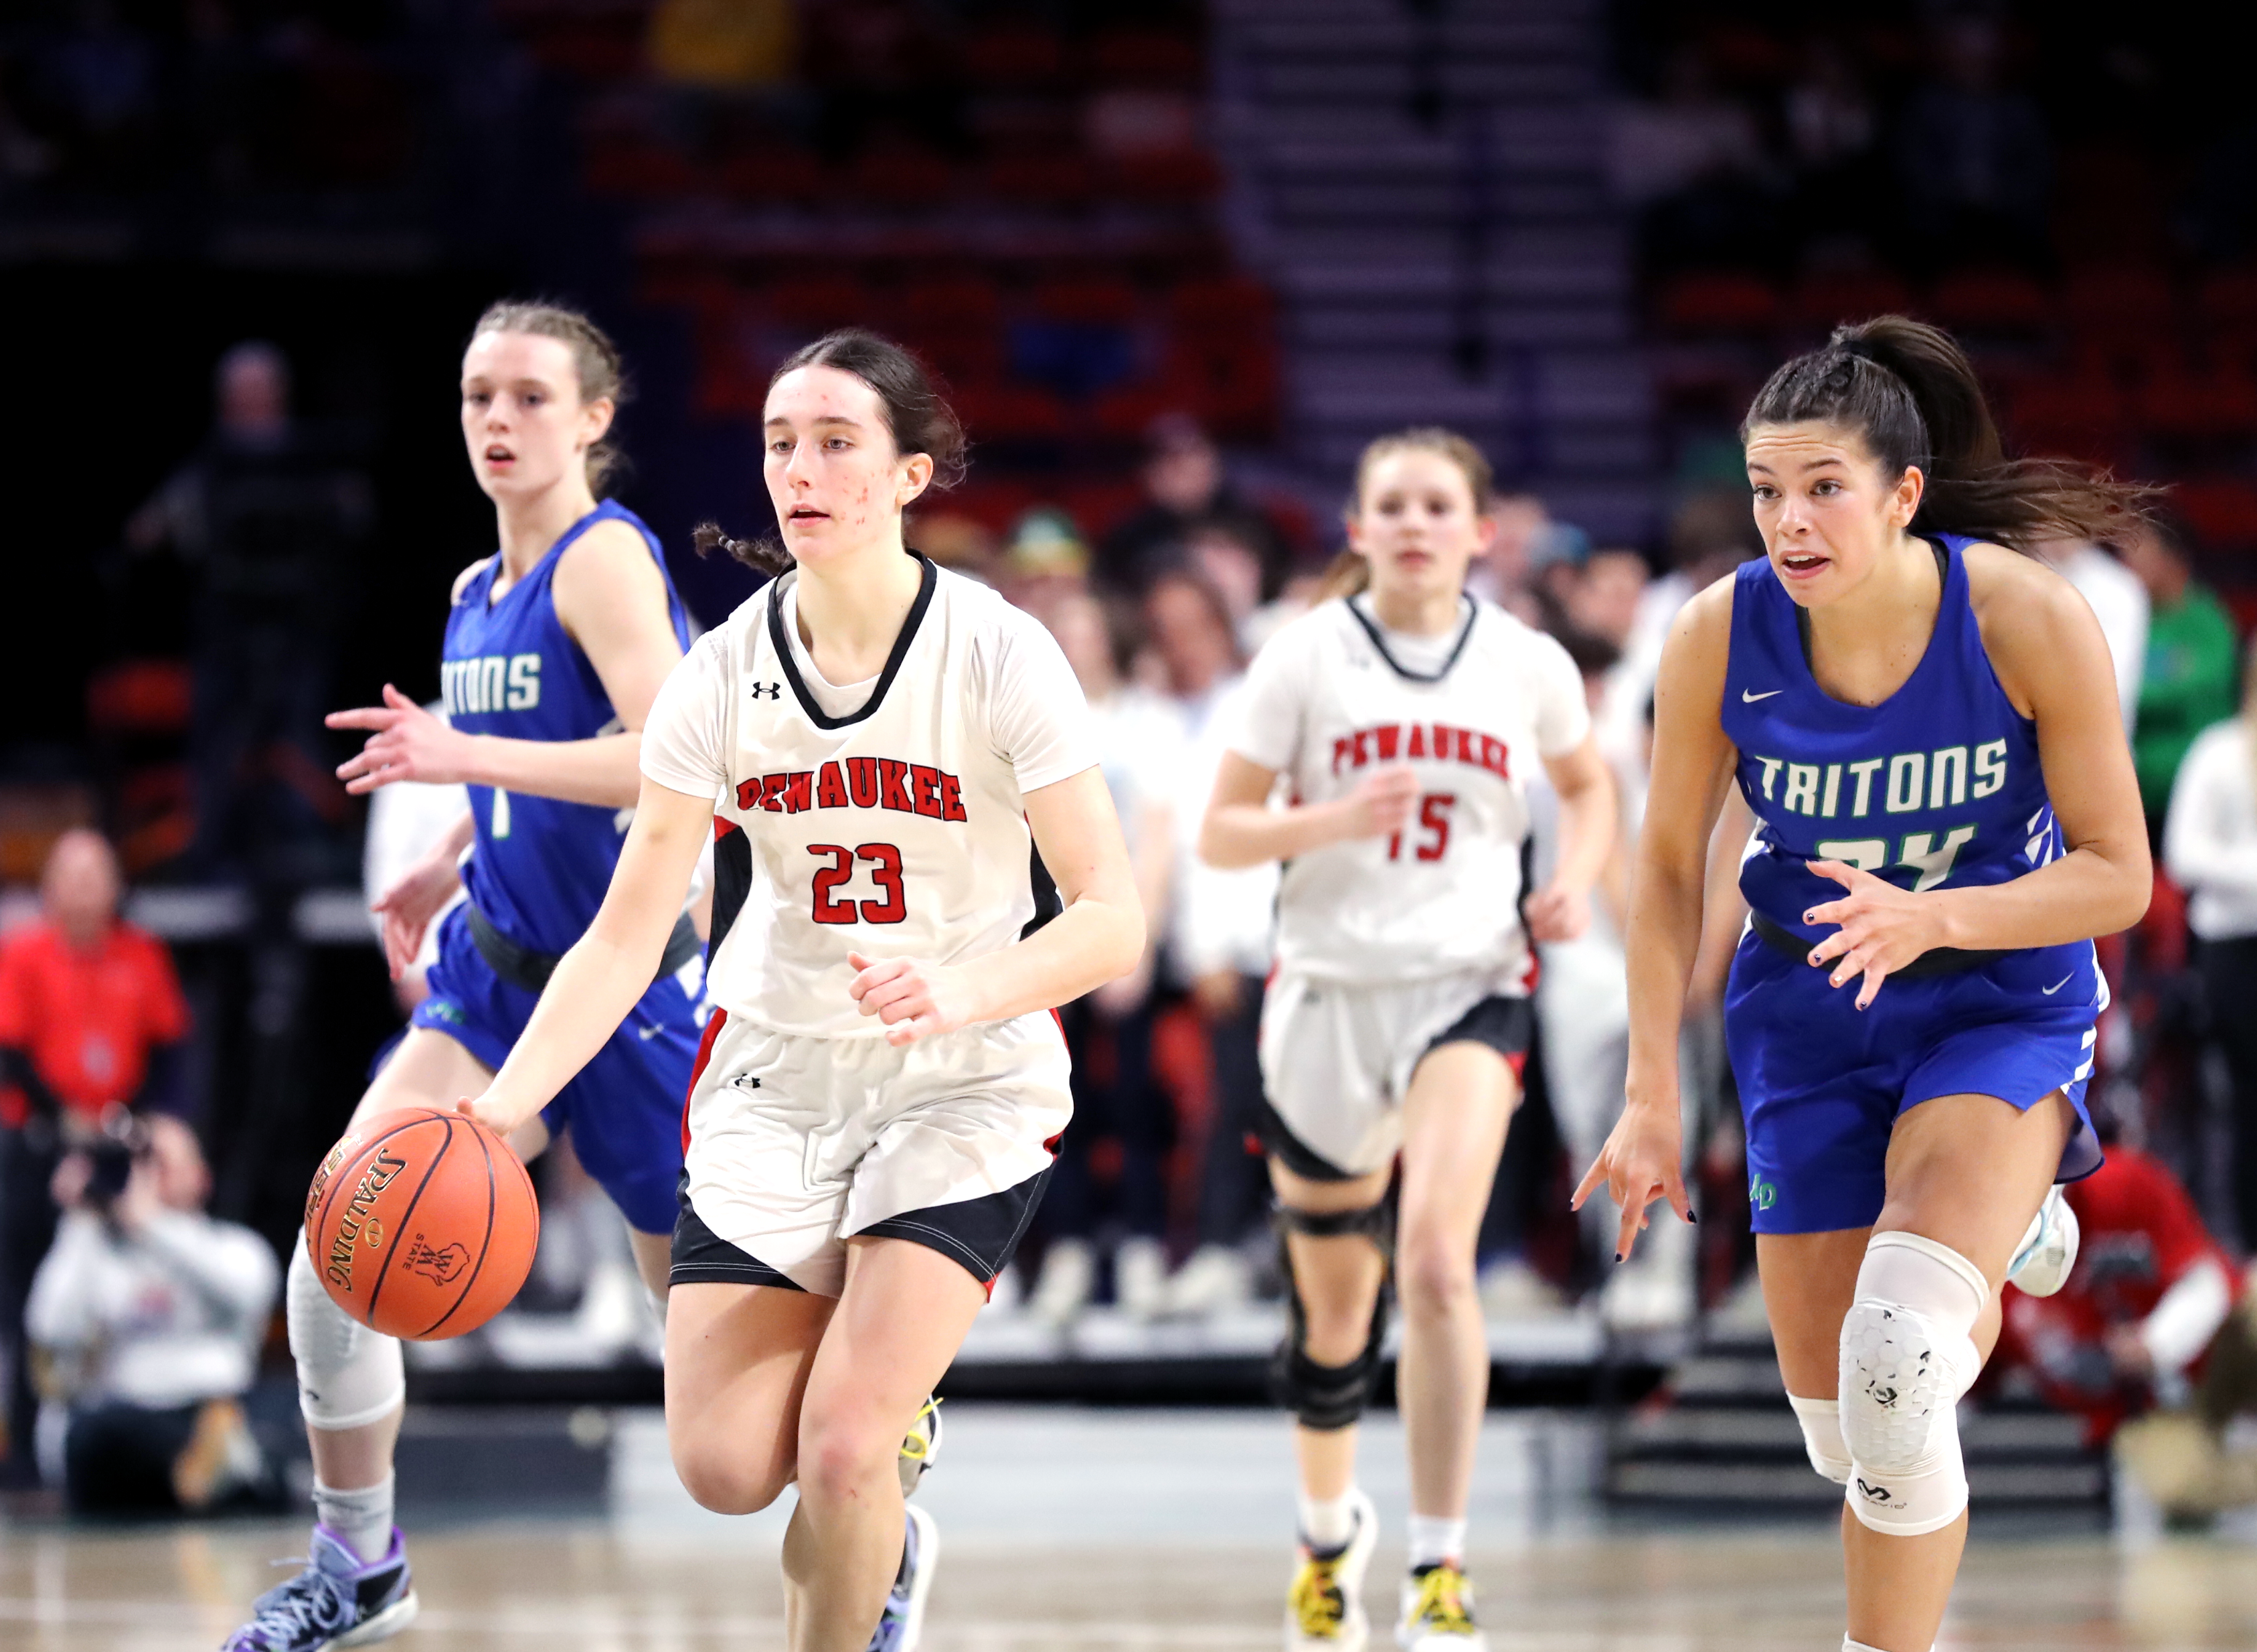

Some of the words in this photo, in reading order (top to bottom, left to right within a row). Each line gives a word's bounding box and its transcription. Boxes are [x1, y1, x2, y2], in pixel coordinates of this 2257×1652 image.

[736, 757, 968, 823] PEWAUKEE
[1754, 737, 2007, 818] TRITONS
[807, 842, 907, 924] 23
[327, 1147, 408, 1293] SPALDING
[402, 1233, 425, 1271] STATE
